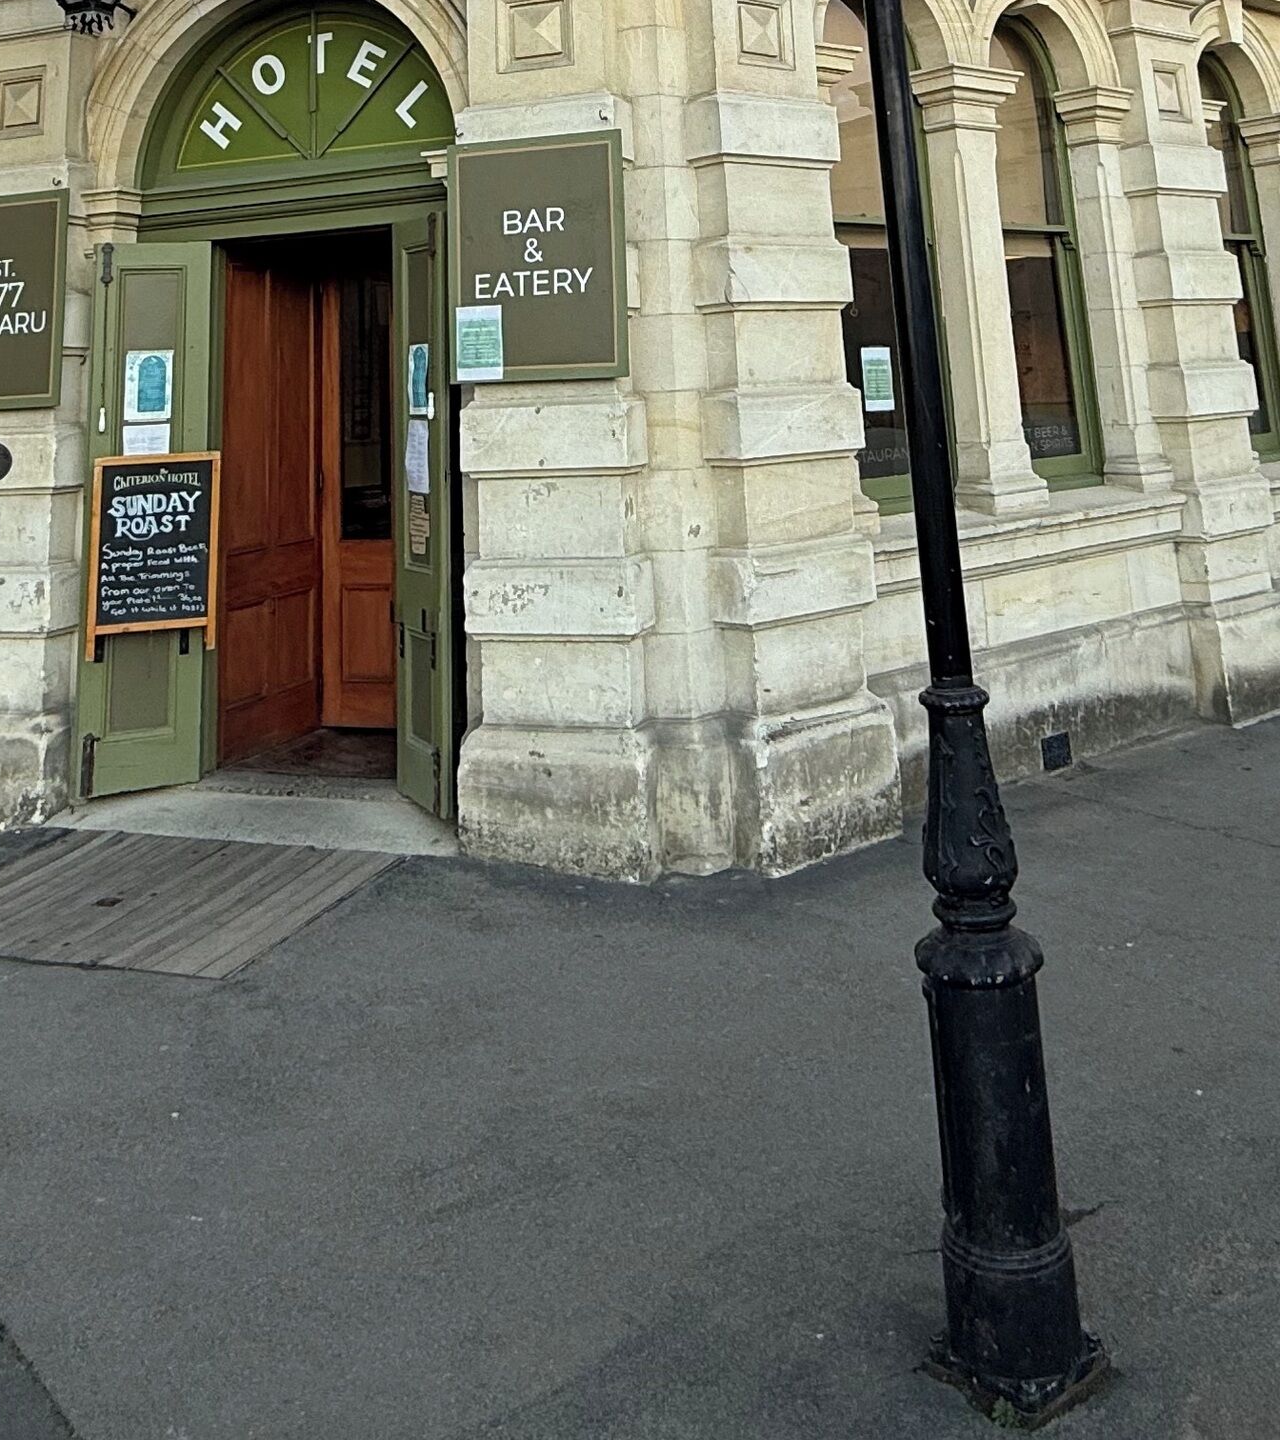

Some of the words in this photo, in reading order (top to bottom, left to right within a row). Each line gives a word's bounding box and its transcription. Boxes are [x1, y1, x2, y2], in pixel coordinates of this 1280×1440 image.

[200, 32, 430, 150] HOTEL
[502, 207, 566, 236] BAR
[523, 239, 543, 264] &
[474, 267, 594, 301] EATERY
[167, 472, 201, 487] HOTEL
[107, 491, 202, 517] SUNDAY
[114, 514, 191, 541] ROAST
[102, 543, 143, 561] Sunday
